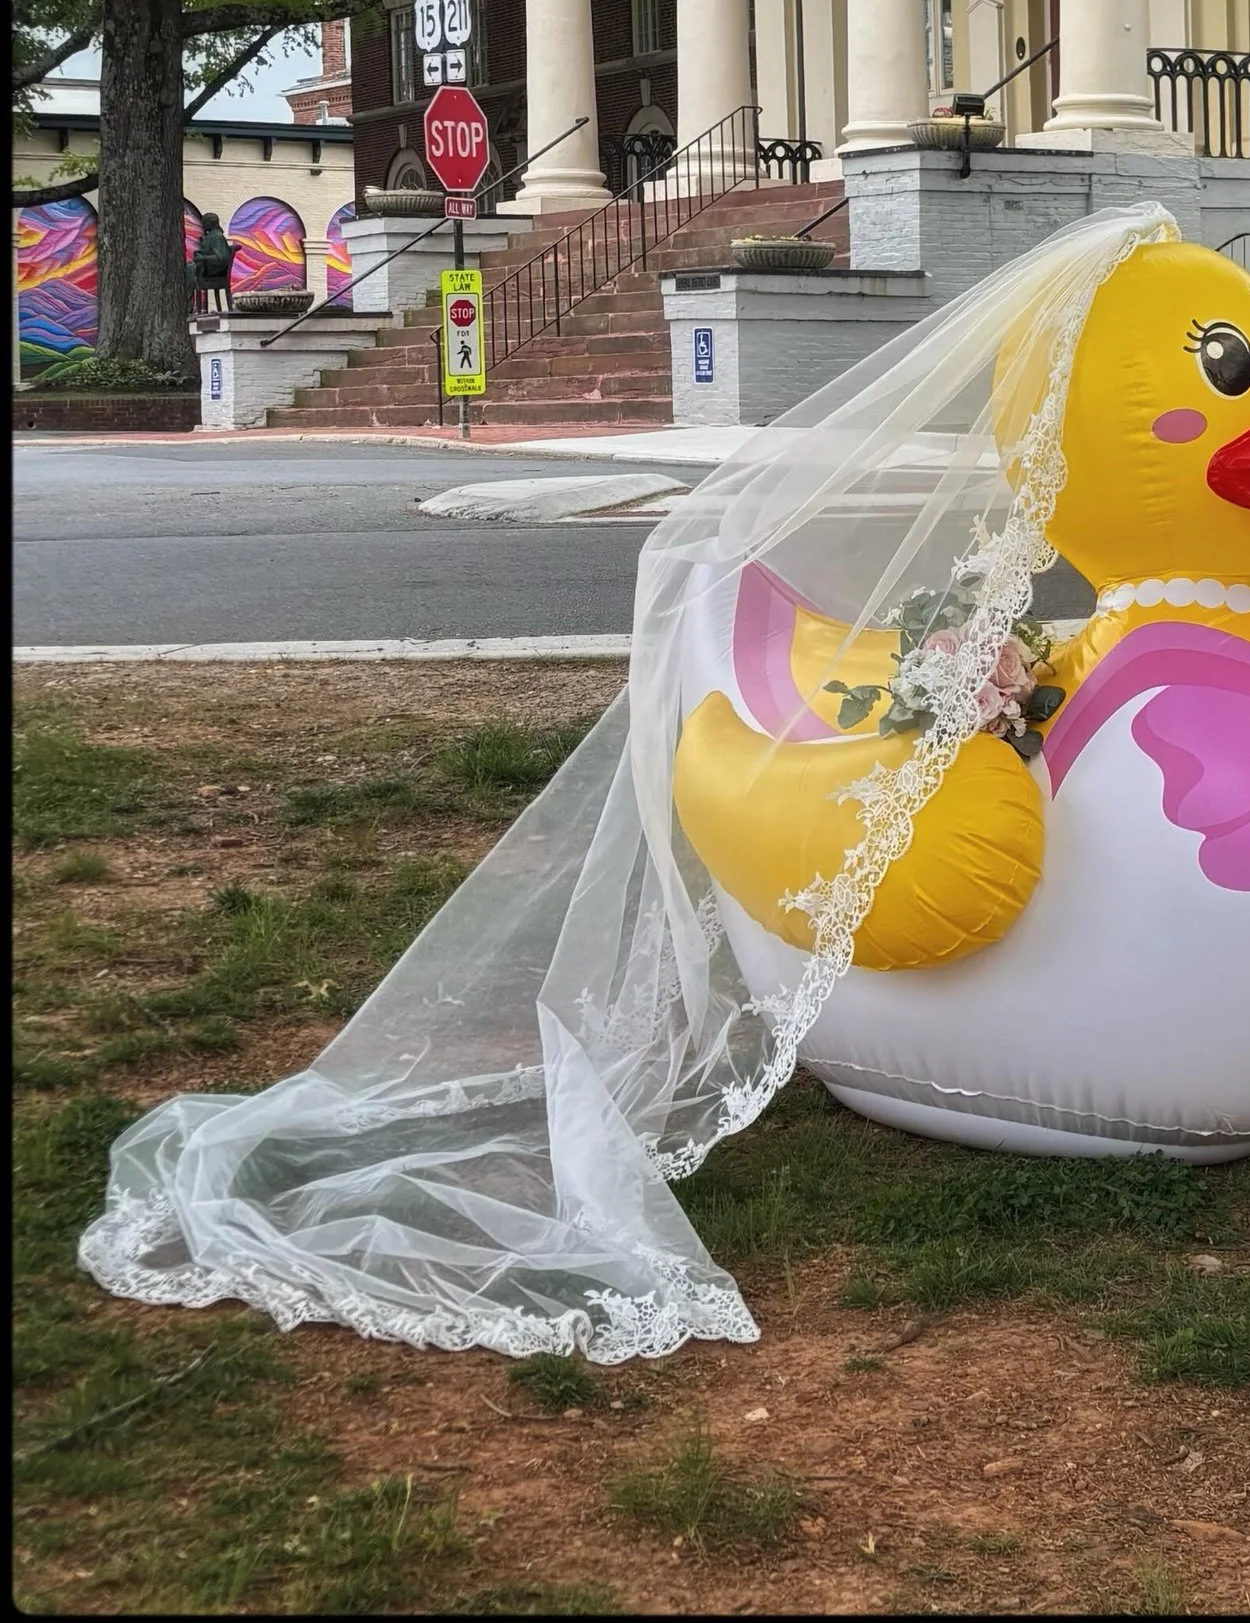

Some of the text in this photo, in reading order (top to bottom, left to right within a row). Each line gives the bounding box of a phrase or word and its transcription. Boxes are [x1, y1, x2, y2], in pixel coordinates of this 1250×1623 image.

[420, 4, 436, 38] 15
[431, 120, 484, 158] STOP
[448, 202, 474, 216] ALL WAY
[449, 274, 475, 282] STATE
[453, 283, 471, 291] LAW
[451, 308, 475, 319] STOP
